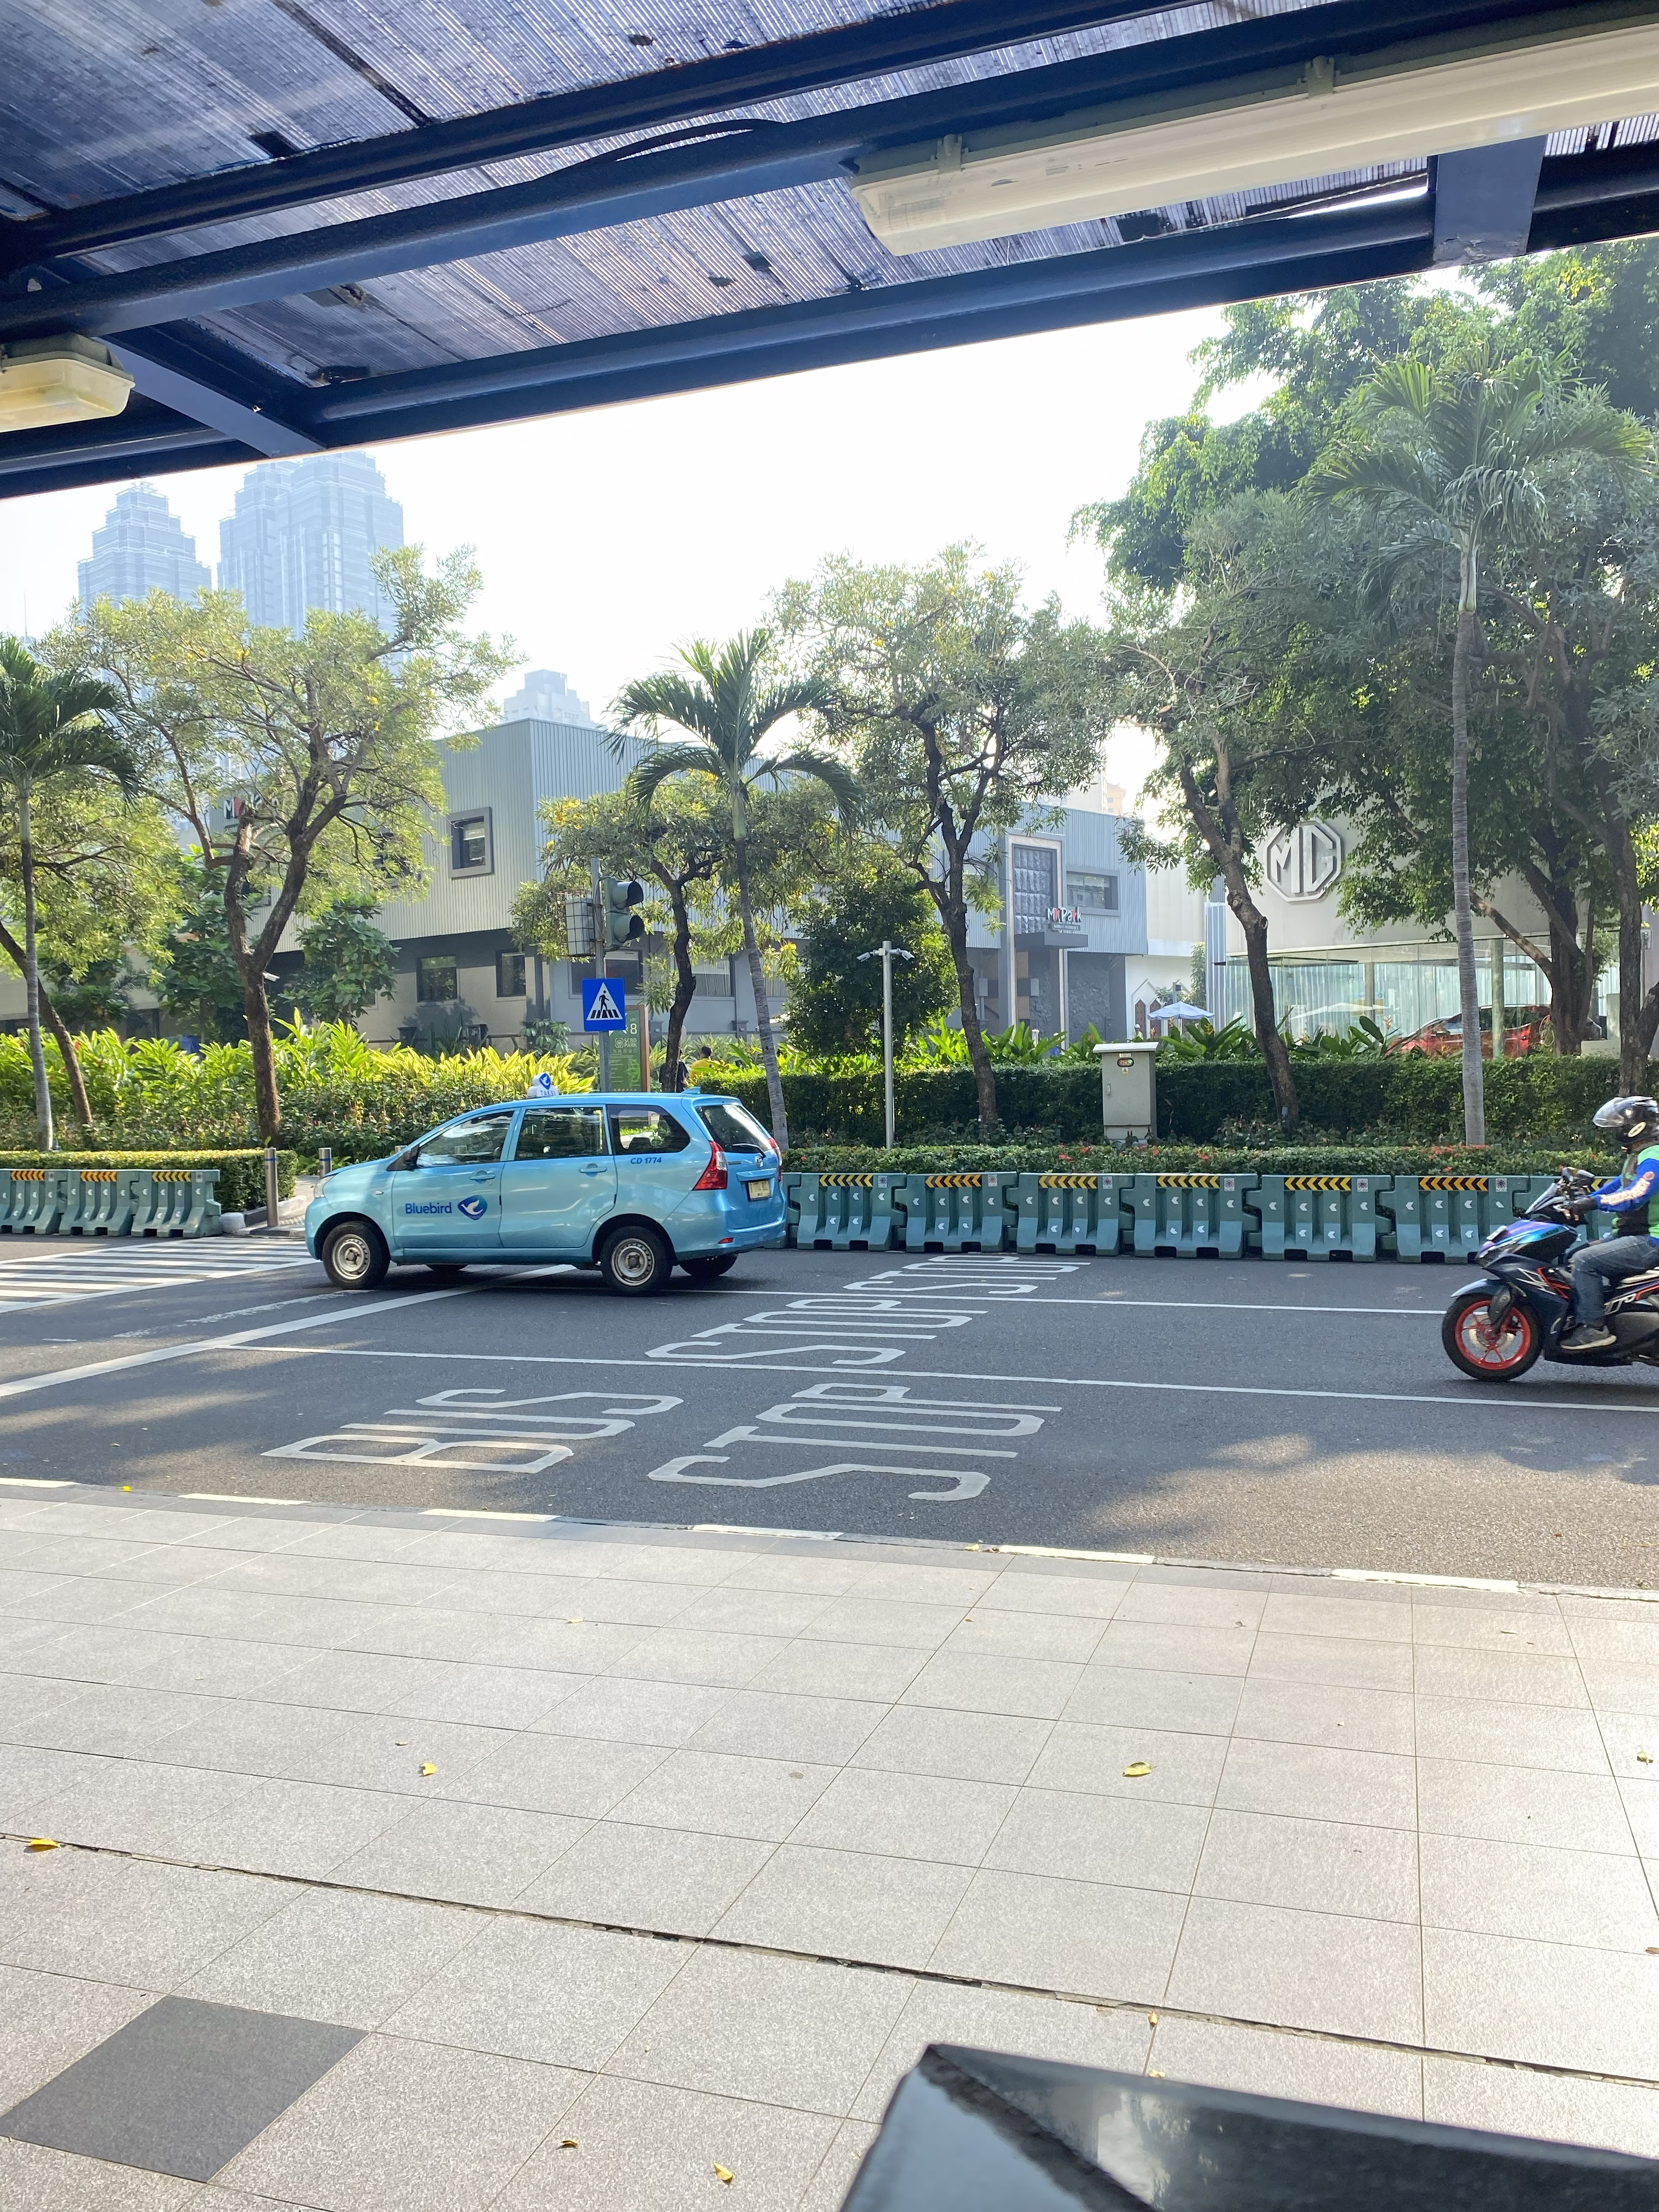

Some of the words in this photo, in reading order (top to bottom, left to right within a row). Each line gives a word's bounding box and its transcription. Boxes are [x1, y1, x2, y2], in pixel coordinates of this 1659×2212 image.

[1271, 825, 1334, 893] MG
[630, 1023, 637, 1035] 8
[405, 1201, 453, 1214] Bluebird
[843, 1255, 1091, 1294] STOP
[645, 1299, 988, 1365] STOP
[261, 1389, 684, 1474] BUS
[647, 1383, 1062, 1502] STOP
